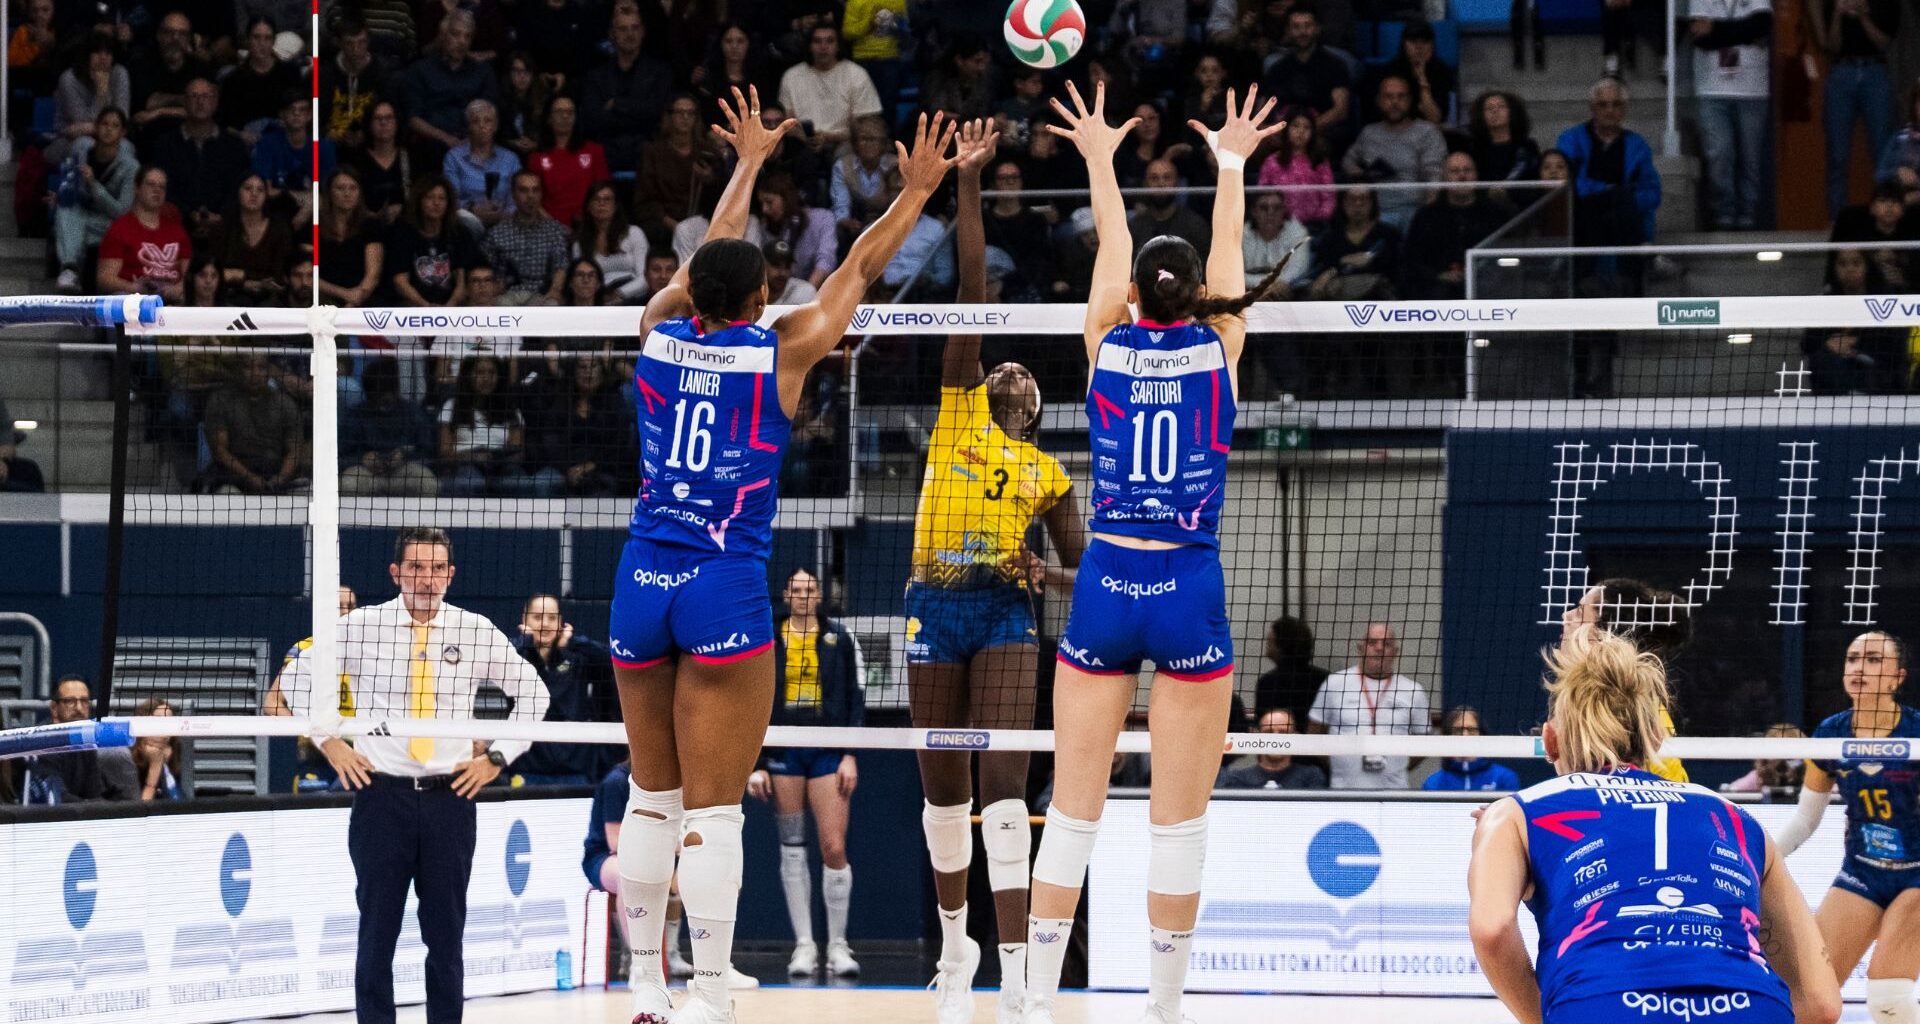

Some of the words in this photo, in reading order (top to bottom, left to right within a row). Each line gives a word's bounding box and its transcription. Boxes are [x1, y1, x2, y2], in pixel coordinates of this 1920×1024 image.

[877, 312, 1011, 325] VEROVOLLEY
[1379, 308, 1518, 322] VEROVOLLEY
[1679, 306, 1716, 318] numia
[395, 315, 523, 328] VEROVOLLEY
[687, 348, 736, 365] numia
[1143, 353, 1190, 369] numia
[679, 368, 721, 397] LANIER
[1130, 379, 1182, 404] SARTORI
[665, 398, 716, 472] 16
[1128, 409, 1178, 483] 10
[985, 468, 1009, 501] 3
[1168, 645, 1225, 670] UNIKA
[931, 734, 985, 746] FINECO
[1237, 738, 1291, 749] unobravo
[1847, 743, 1906, 756] FINECO
[1596, 788, 1687, 805] PIETRINI
[1858, 788, 1893, 820] 15
[1631, 801, 1669, 871] 7
